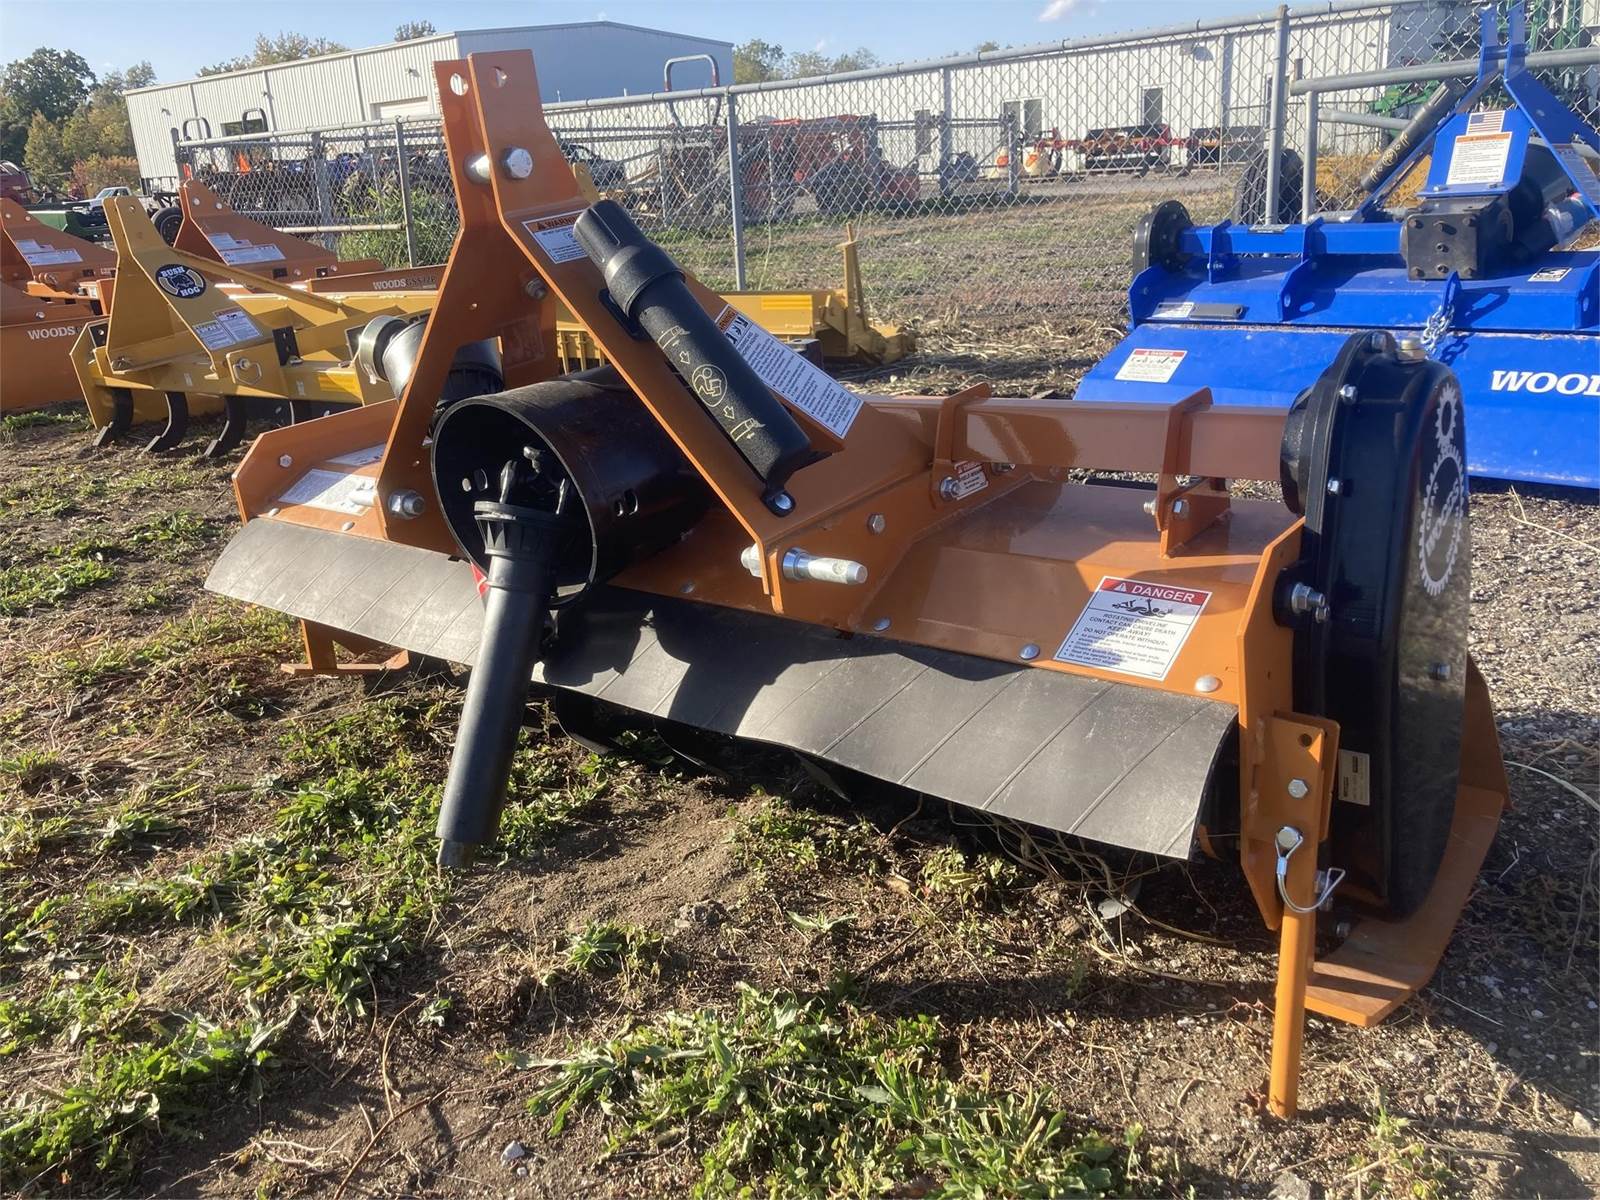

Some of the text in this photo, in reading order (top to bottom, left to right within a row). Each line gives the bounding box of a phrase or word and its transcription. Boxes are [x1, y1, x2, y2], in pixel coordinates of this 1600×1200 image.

[160, 266, 186, 278] BUSH
[372, 278, 407, 290] WOODS
[179, 286, 201, 297] HOG
[27, 326, 76, 340] WOODS
[1131, 584, 1195, 603] DANGER
[1090, 616, 1117, 626] CONTACT
